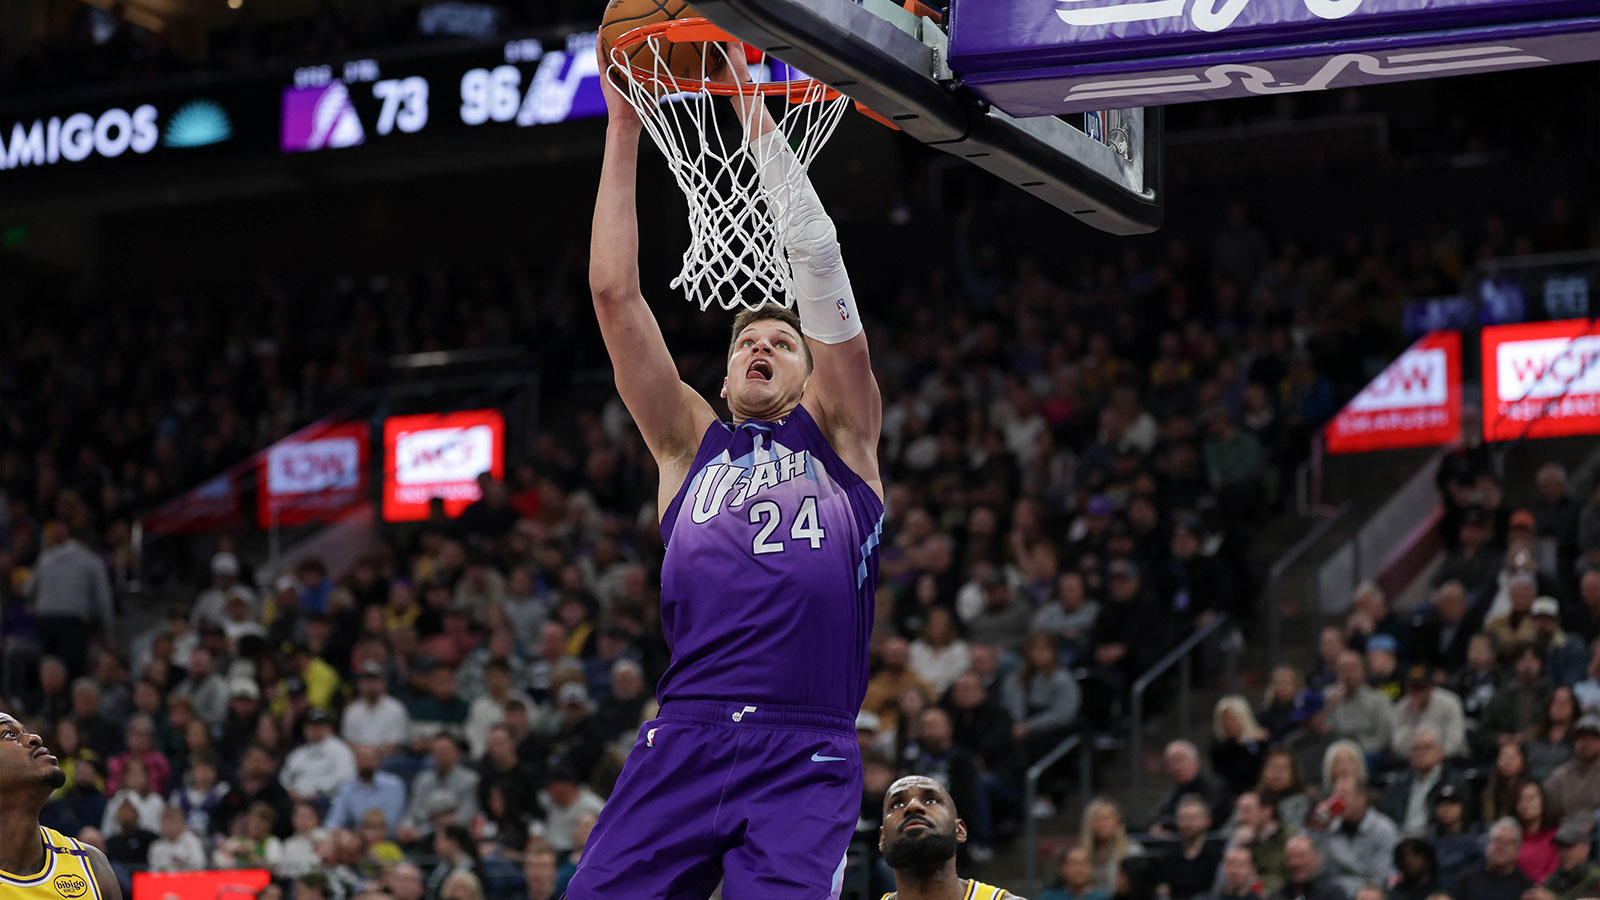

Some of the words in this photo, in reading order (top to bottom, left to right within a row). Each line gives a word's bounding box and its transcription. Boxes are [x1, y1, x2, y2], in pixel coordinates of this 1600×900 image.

[372, 75, 429, 135] 73
[460, 65, 521, 125] 96
[691, 450, 808, 524] UTAH
[748, 496, 826, 555] 24
[56, 880, 85, 890] bibigo
